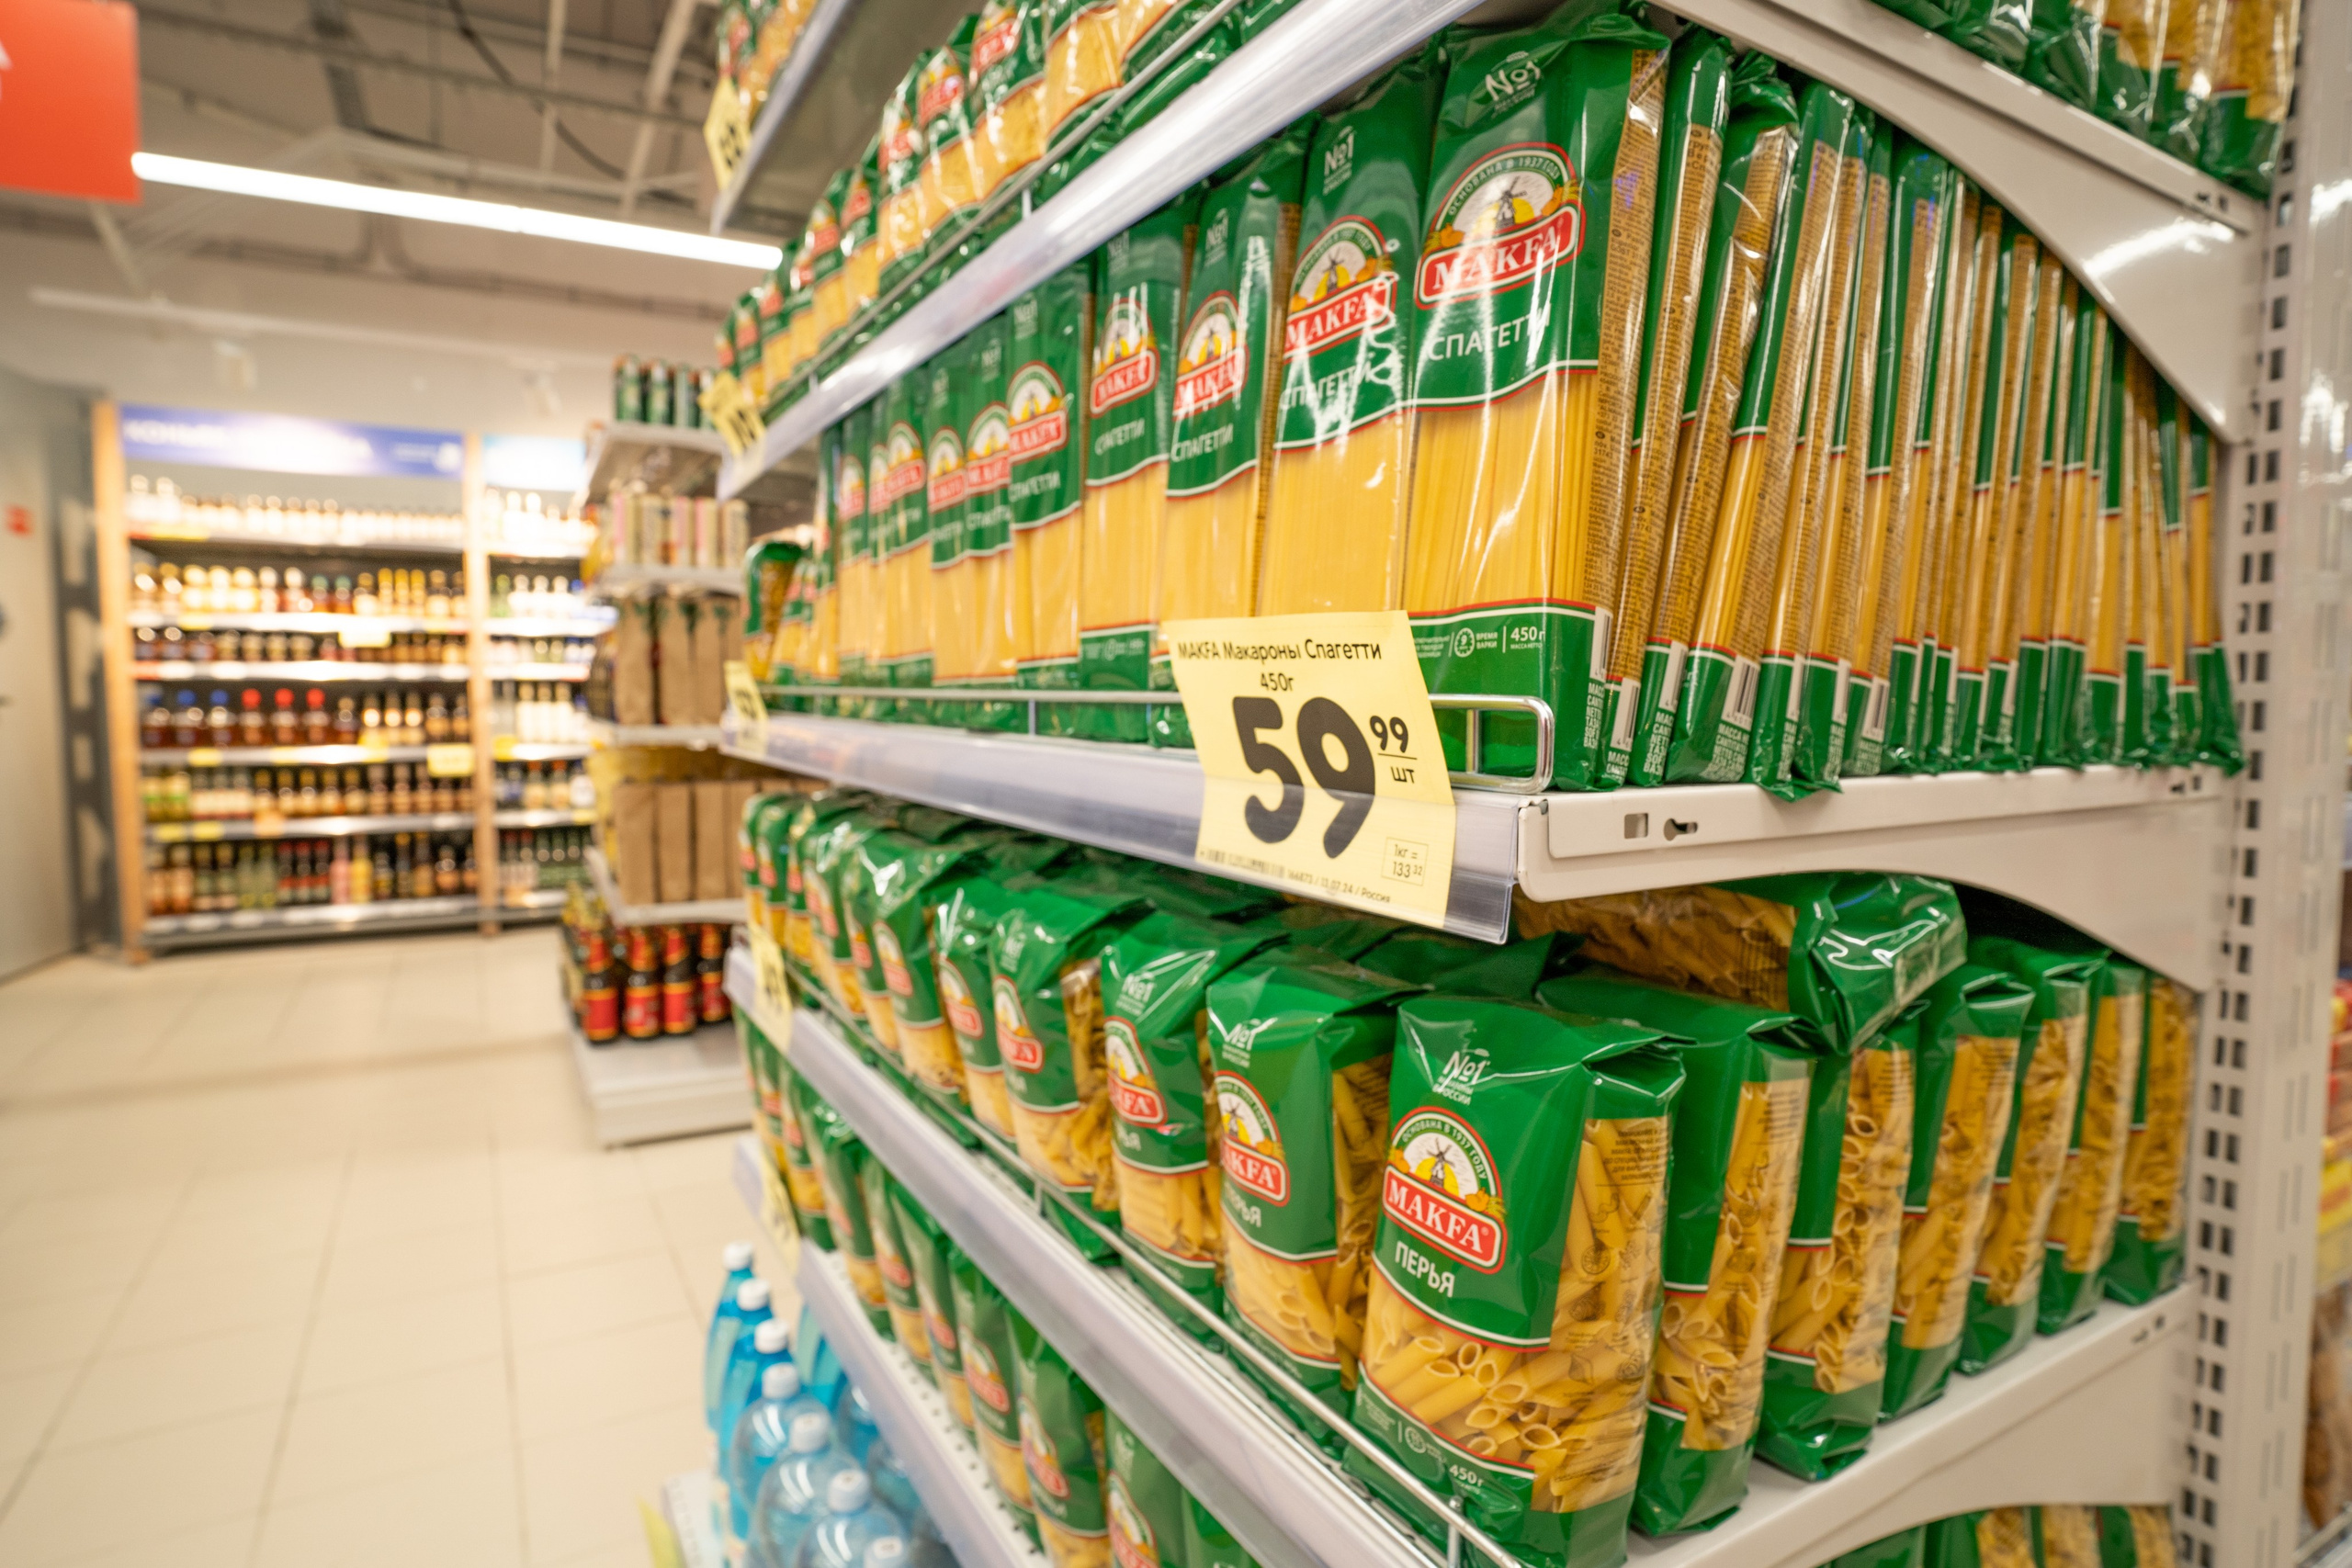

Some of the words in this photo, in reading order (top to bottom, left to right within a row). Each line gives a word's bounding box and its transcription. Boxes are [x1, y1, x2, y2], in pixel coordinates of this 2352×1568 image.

[1432, 225, 1558, 290] MAKFA
[1224, 641, 1301, 664] Макароны
[1305, 639, 1382, 660] Спагетти
[1261, 672, 1295, 691] 450г
[1232, 696, 1376, 859] 59
[1369, 716, 1408, 753] 99
[1392, 861, 1411, 879] 133
[1413, 865, 1423, 876] 32
[1394, 843, 1408, 859] 1кг
[1362, 887, 1391, 903] Россия
[1402, 1120, 1442, 1143] ОСНОВАНА
[1452, 1129, 1471, 1150] 1937
[1468, 1150, 1487, 1179] ГОДУ
[1388, 1179, 1484, 1254] MAKFA
[1395, 1240, 1455, 1298] ПЕРЬЯ
